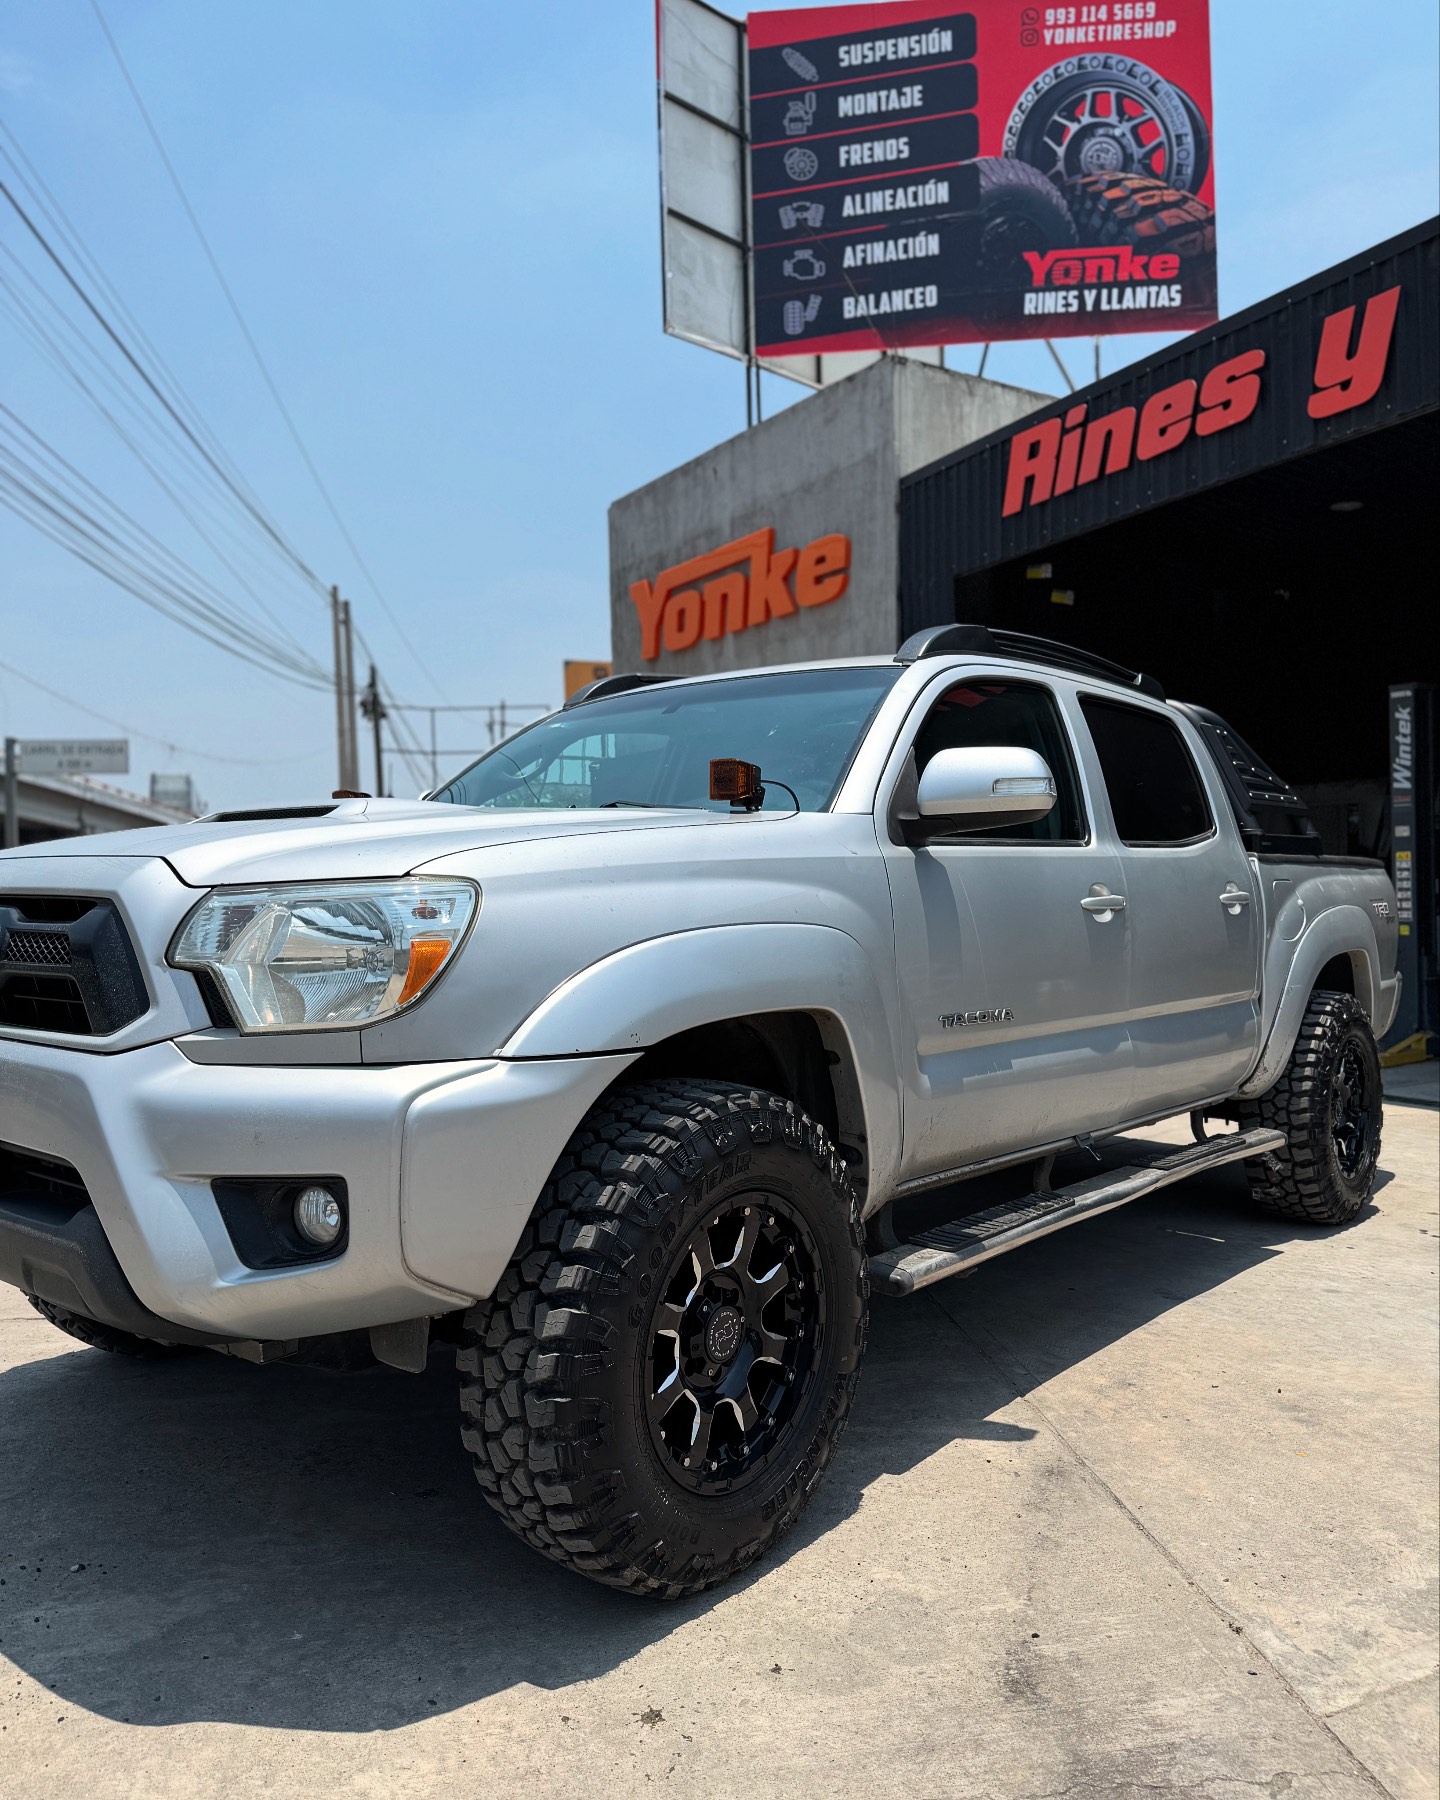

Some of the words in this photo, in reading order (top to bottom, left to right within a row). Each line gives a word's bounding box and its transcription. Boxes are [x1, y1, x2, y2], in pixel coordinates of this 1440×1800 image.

[1043, 20, 1177, 46] YONKETIRESHOP
[1045, 8, 1076, 26] 993
[1081, 5, 1108, 23] 114
[1113, 2, 1156, 20] 5669
[838, 27, 953, 68] SUSPENSIÓN
[838, 84, 923, 118] MONTAJE
[839, 136, 910, 168] FRENOS
[842, 178, 950, 218] ALINEACIÓN
[842, 230, 940, 269] AFINACIÓN
[1022, 245, 1181, 288] Yonke
[842, 284, 938, 320] BALANCEO
[1023, 290, 1079, 316] RINES
[1083, 288, 1097, 313] Y
[1100, 284, 1182, 312] LLANTAS
[1001, 349, 1266, 518] Rines
[1307, 284, 1401, 420] y
[629, 527, 851, 661] Yonke
[1392, 704, 1412, 789] Wintek
[938, 1007, 1014, 1029] TACOMA
[760, 1372, 850, 1523] WRANGLER
